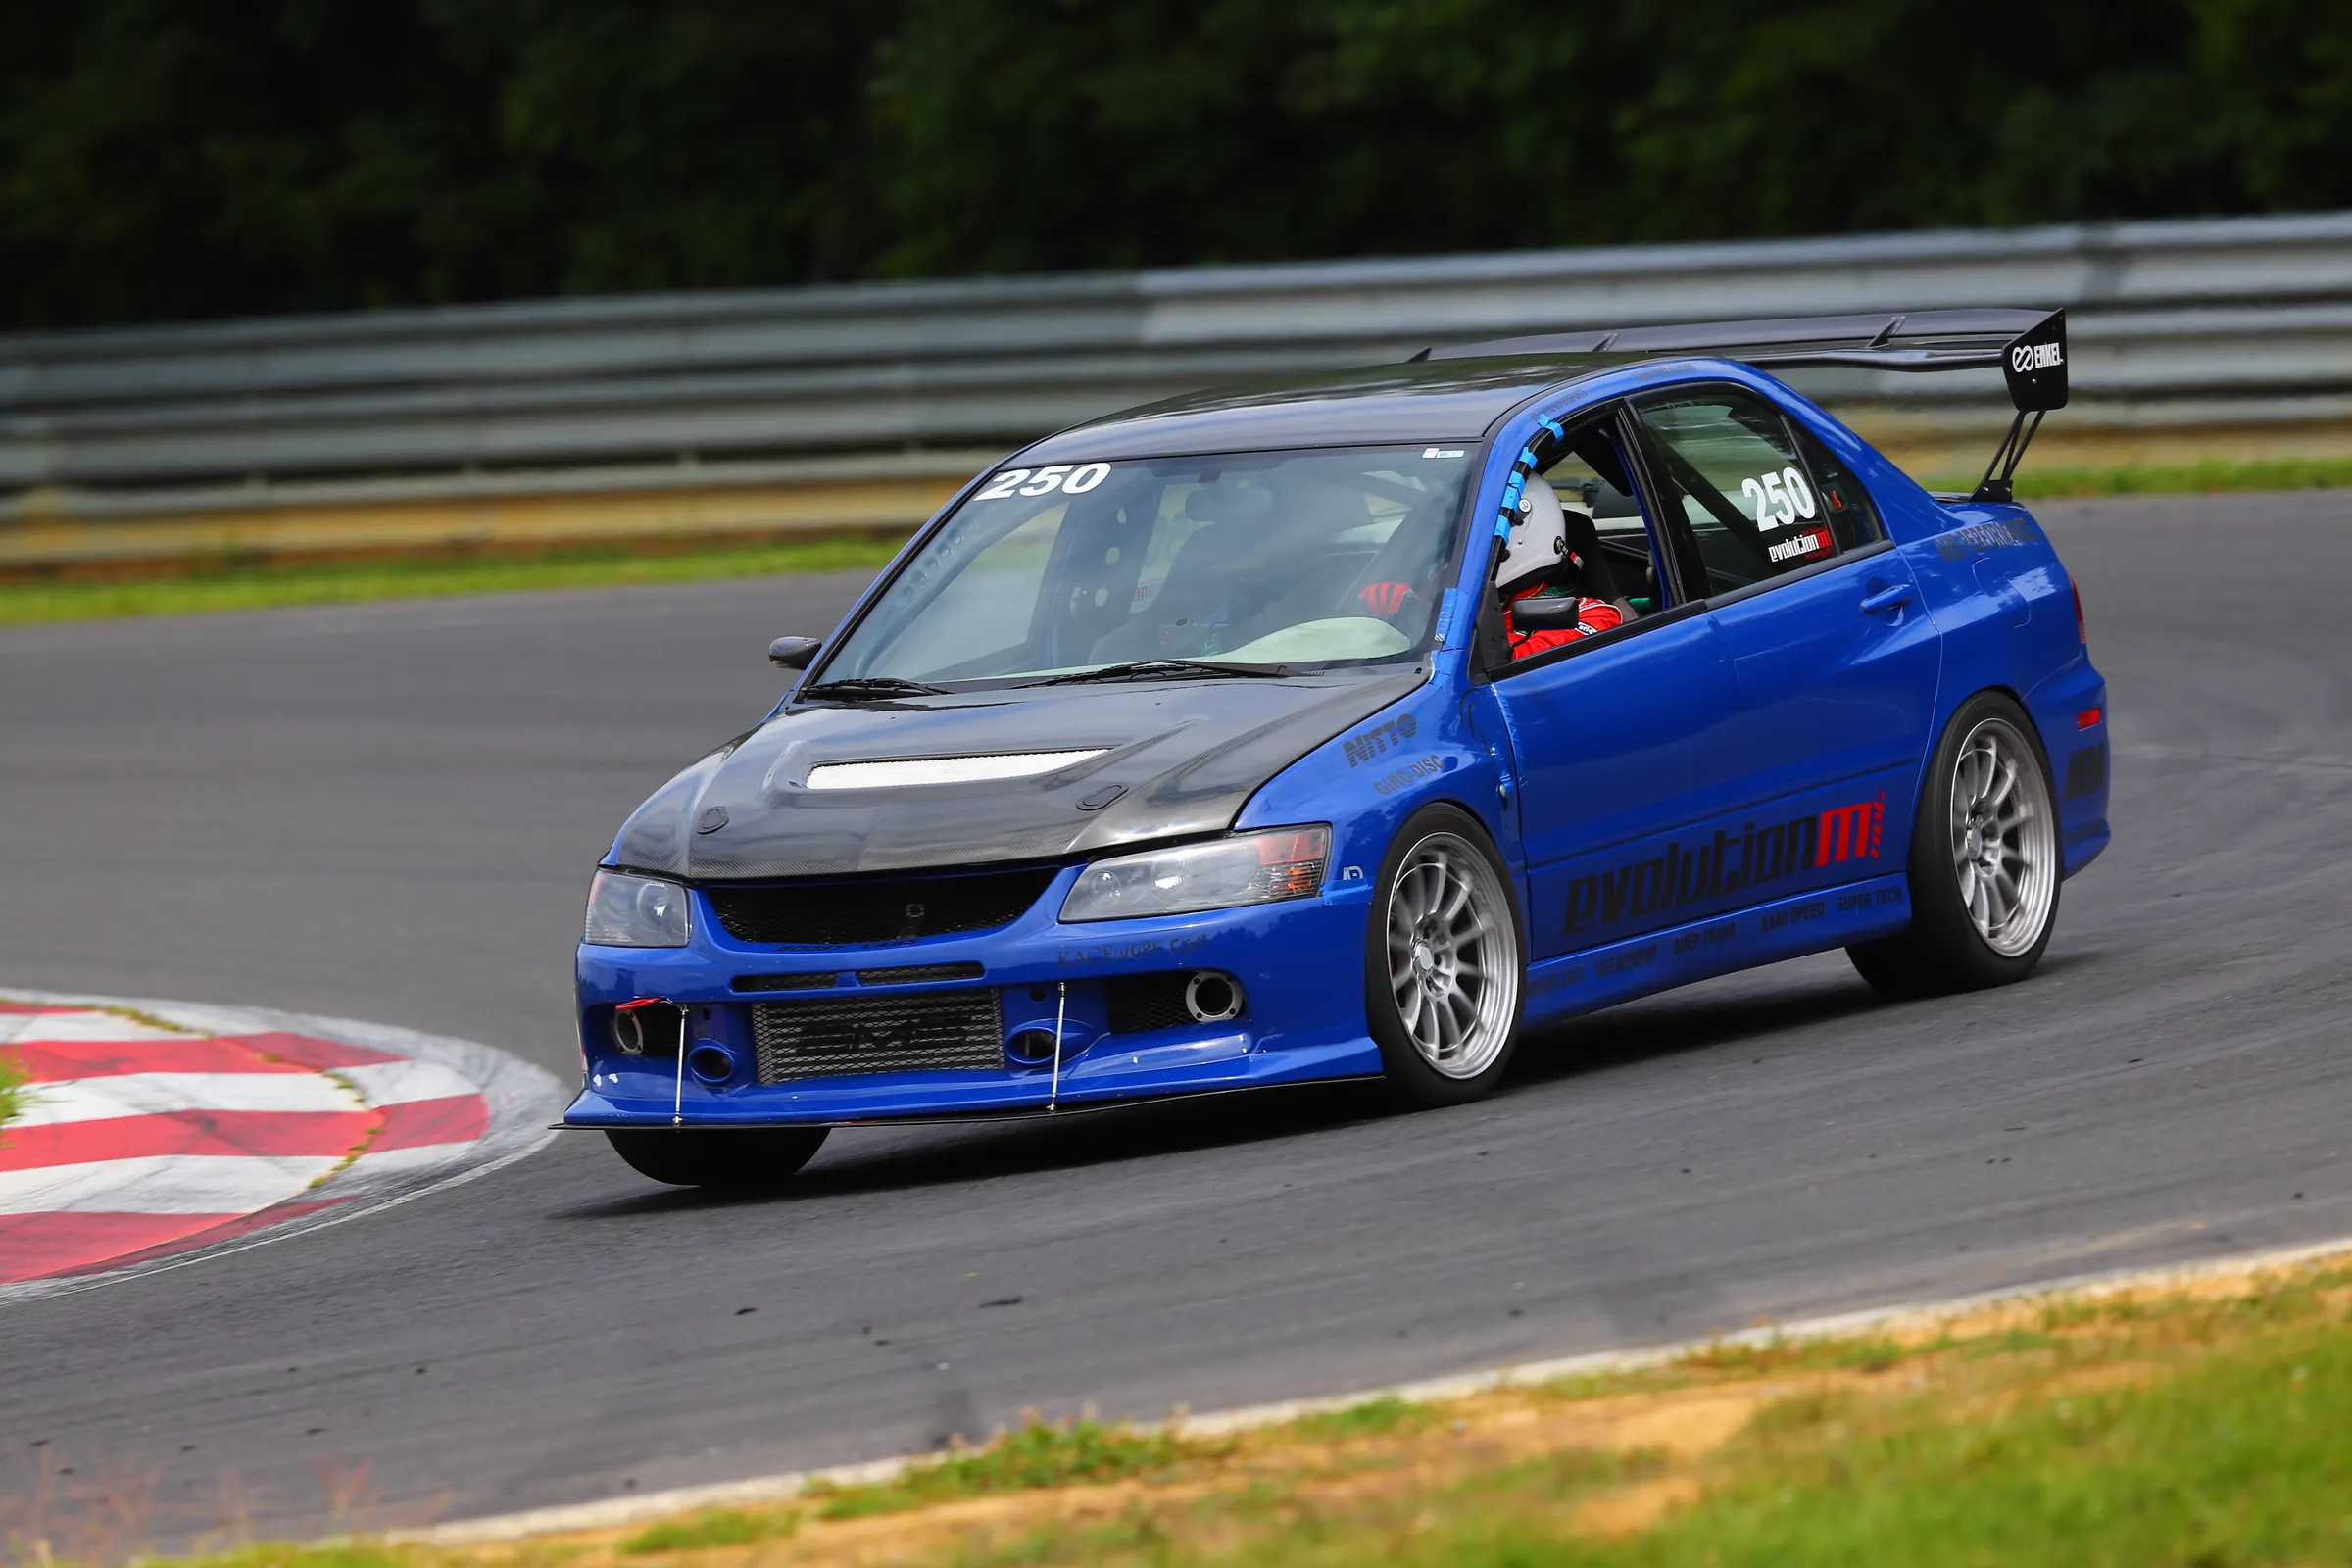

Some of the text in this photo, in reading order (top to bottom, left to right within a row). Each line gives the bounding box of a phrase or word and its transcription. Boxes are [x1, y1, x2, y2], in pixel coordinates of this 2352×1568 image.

[973, 462, 1112, 501] 250
[1741, 466, 1816, 532] 250
[1343, 713, 1417, 768] NITTO
[1373, 754, 1446, 795] GIRO-DISC
[1790, 901, 1825, 925] SPEED
[1838, 892, 1872, 912] SUPER
[1874, 886, 1902, 906] TECH
